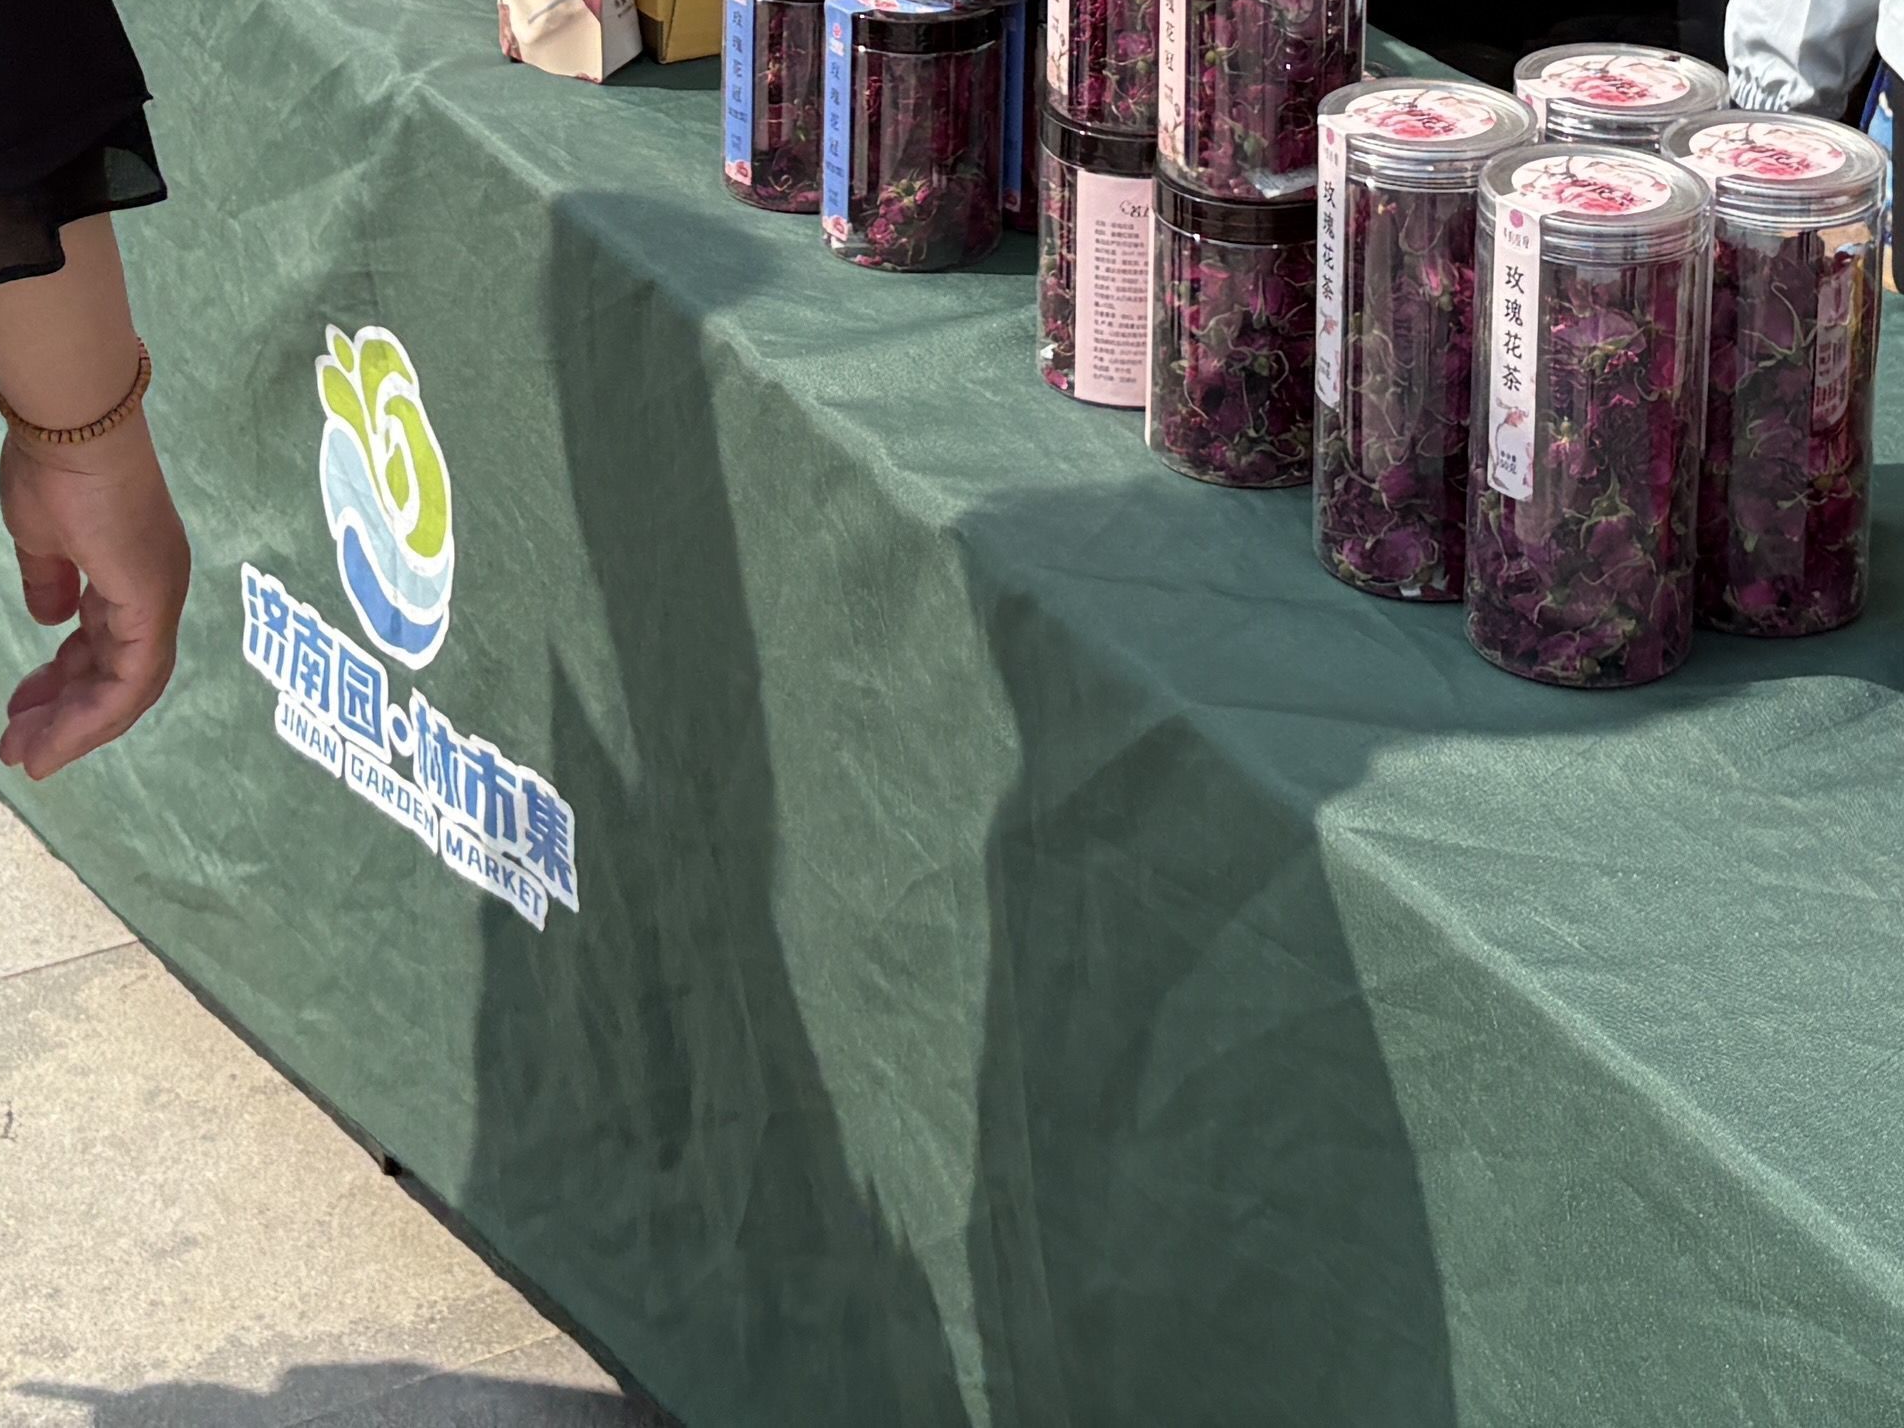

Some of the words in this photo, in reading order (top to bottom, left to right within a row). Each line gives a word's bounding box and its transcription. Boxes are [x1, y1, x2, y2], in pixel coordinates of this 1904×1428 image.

[1321, 179, 1338, 303] 玫瑰花茶
[1501, 263, 1526, 394] 玫瑰花茶
[247, 573, 572, 894] 济南园·林市集
[280, 702, 337, 765] JINAN
[349, 757, 435, 832] GARDEN
[445, 835, 543, 916] MARKET
